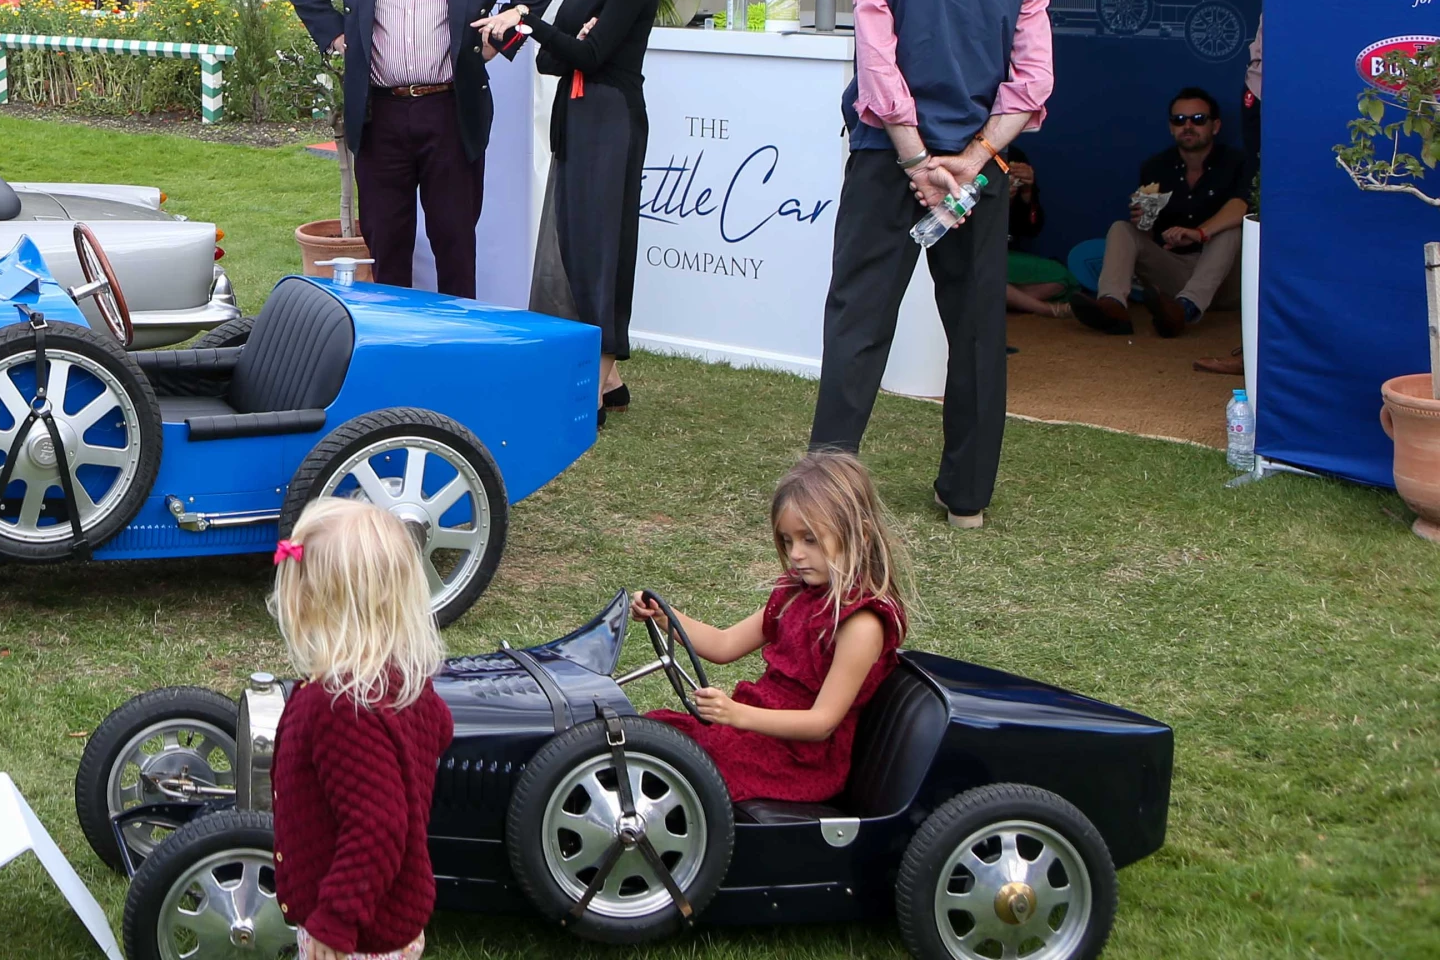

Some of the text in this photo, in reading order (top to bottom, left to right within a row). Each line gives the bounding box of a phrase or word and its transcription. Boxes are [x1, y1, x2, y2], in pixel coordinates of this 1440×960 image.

[684, 116, 730, 140] THE
[639, 144, 833, 243] ttle Car
[646, 245, 764, 280] COMPANY
